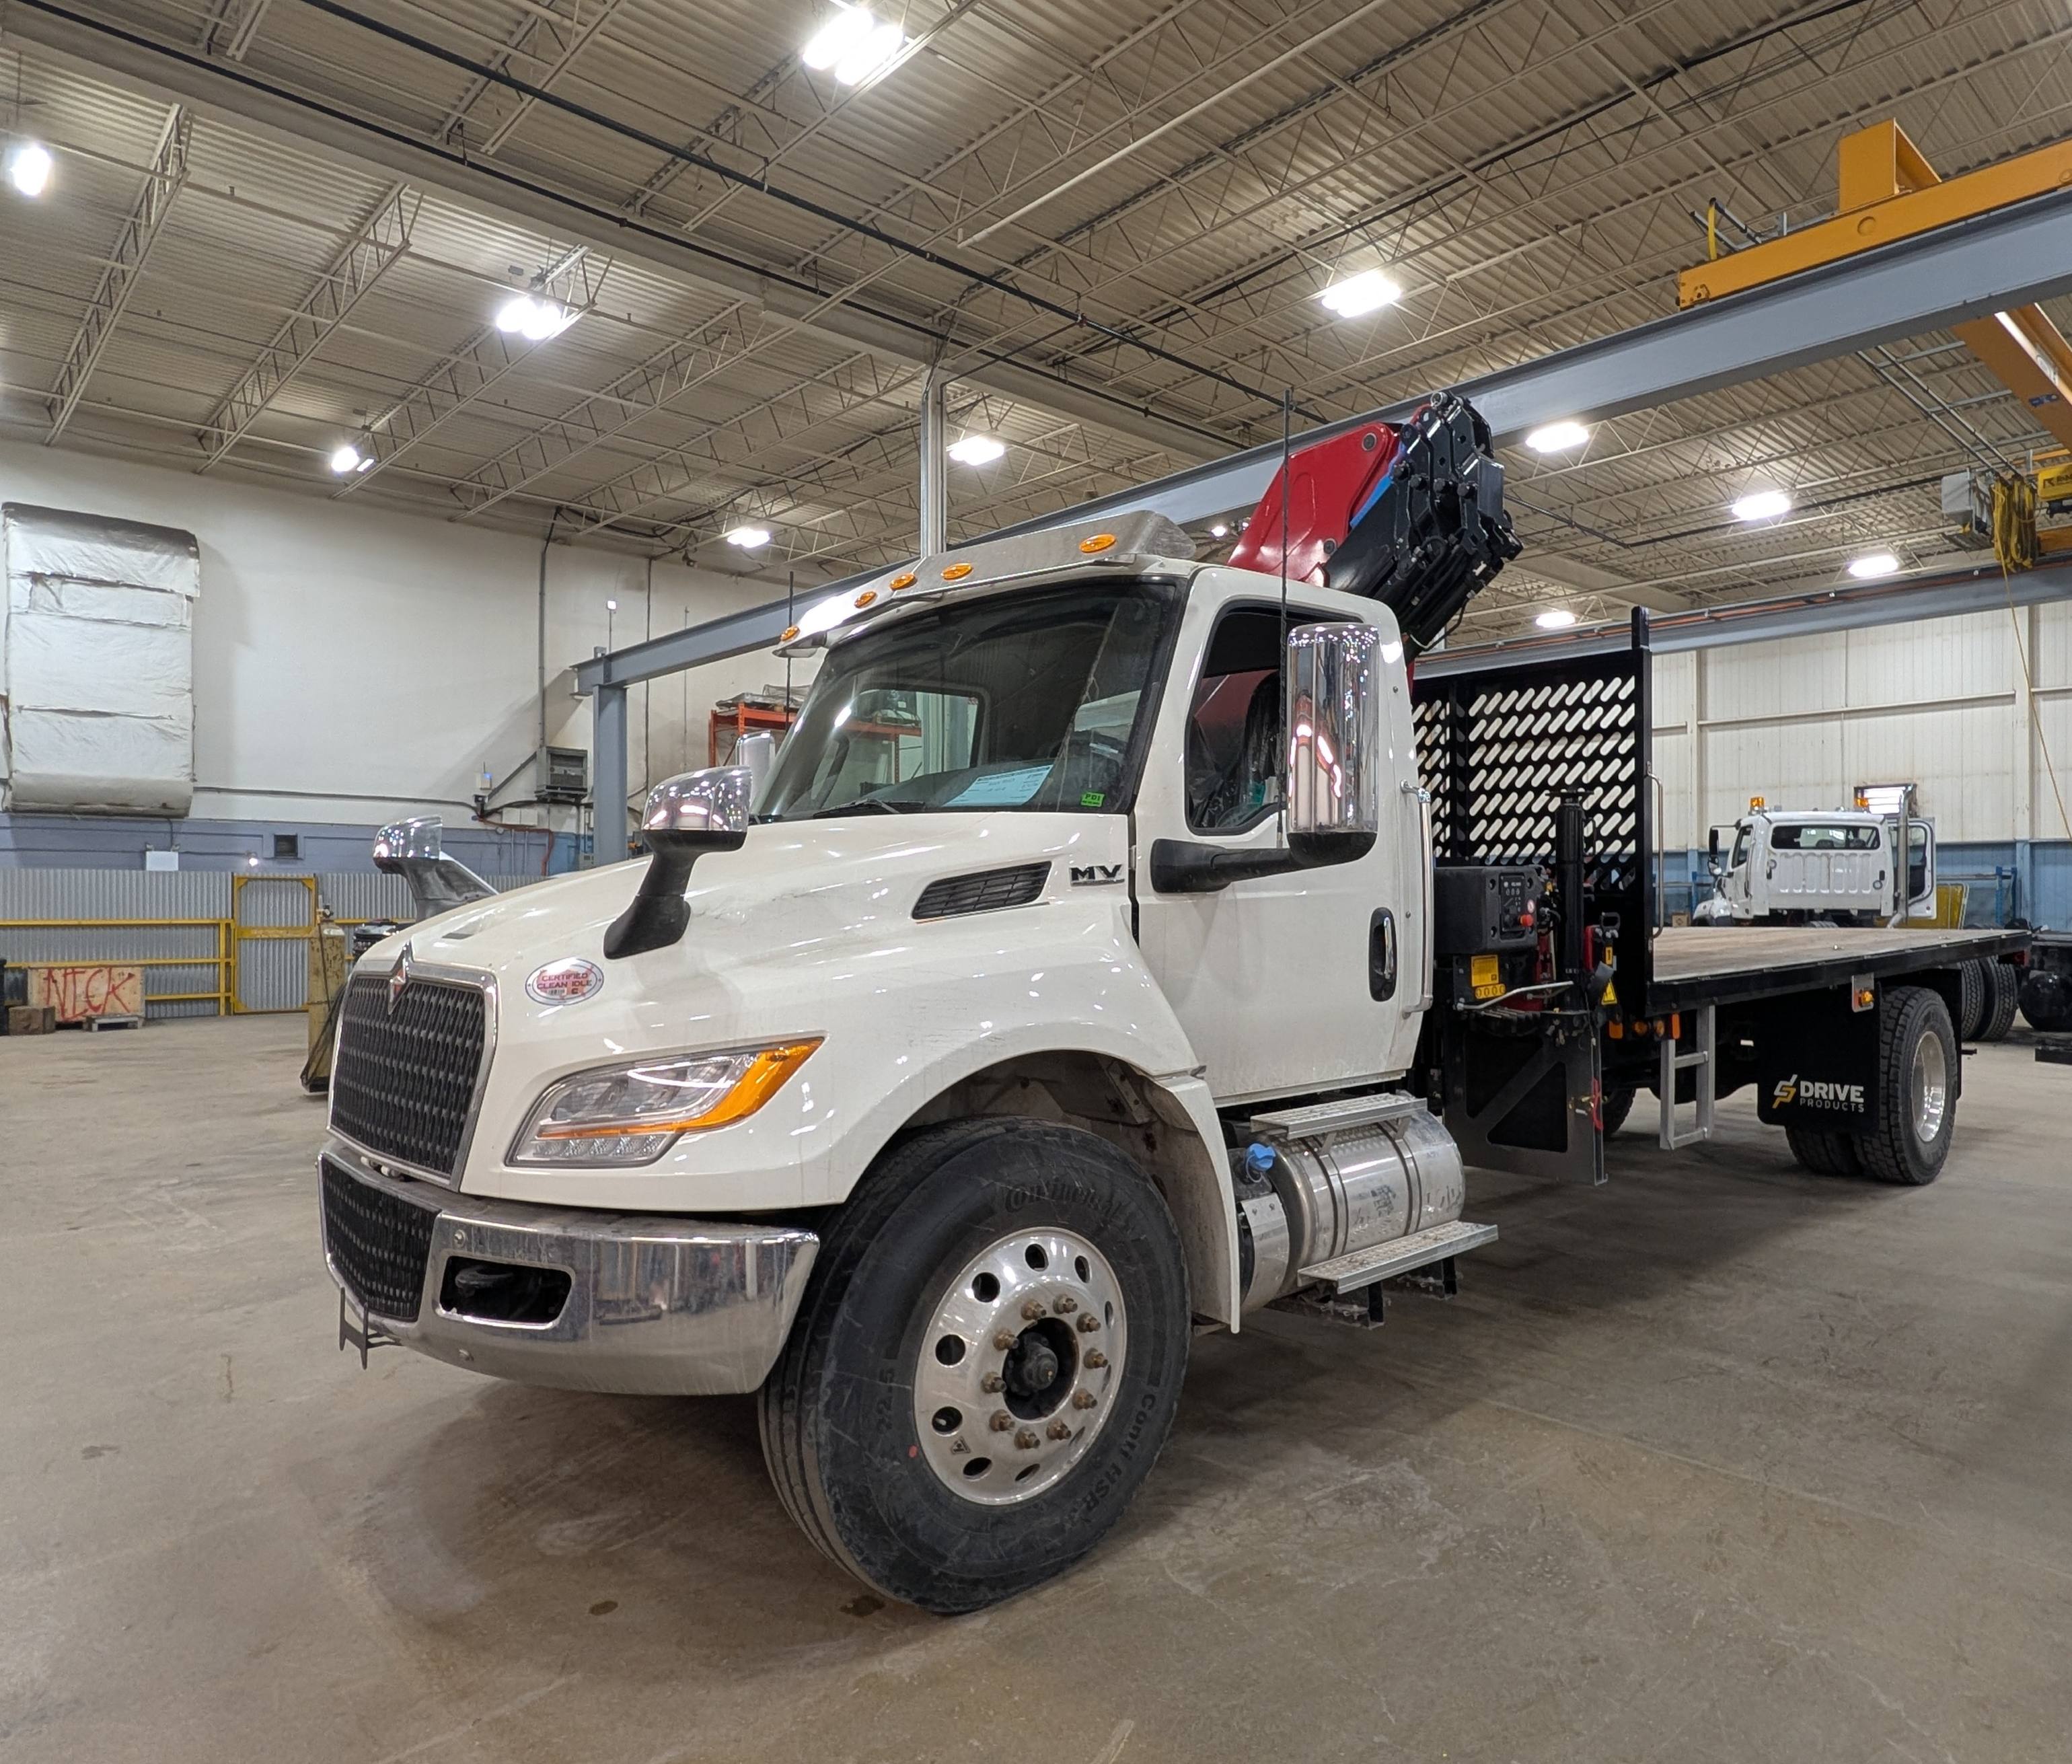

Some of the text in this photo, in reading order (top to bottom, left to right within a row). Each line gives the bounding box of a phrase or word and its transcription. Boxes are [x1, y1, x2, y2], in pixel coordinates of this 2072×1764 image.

[1070, 864, 1122, 881] MV
[542, 973, 588, 982] CERTIFIED
[42, 967, 135, 1022] NICK
[1800, 1080, 1864, 1103] DRIVE
[1800, 1097, 1864, 1113] PRODUCTS
[1119, 1394, 1156, 1460] Conti
